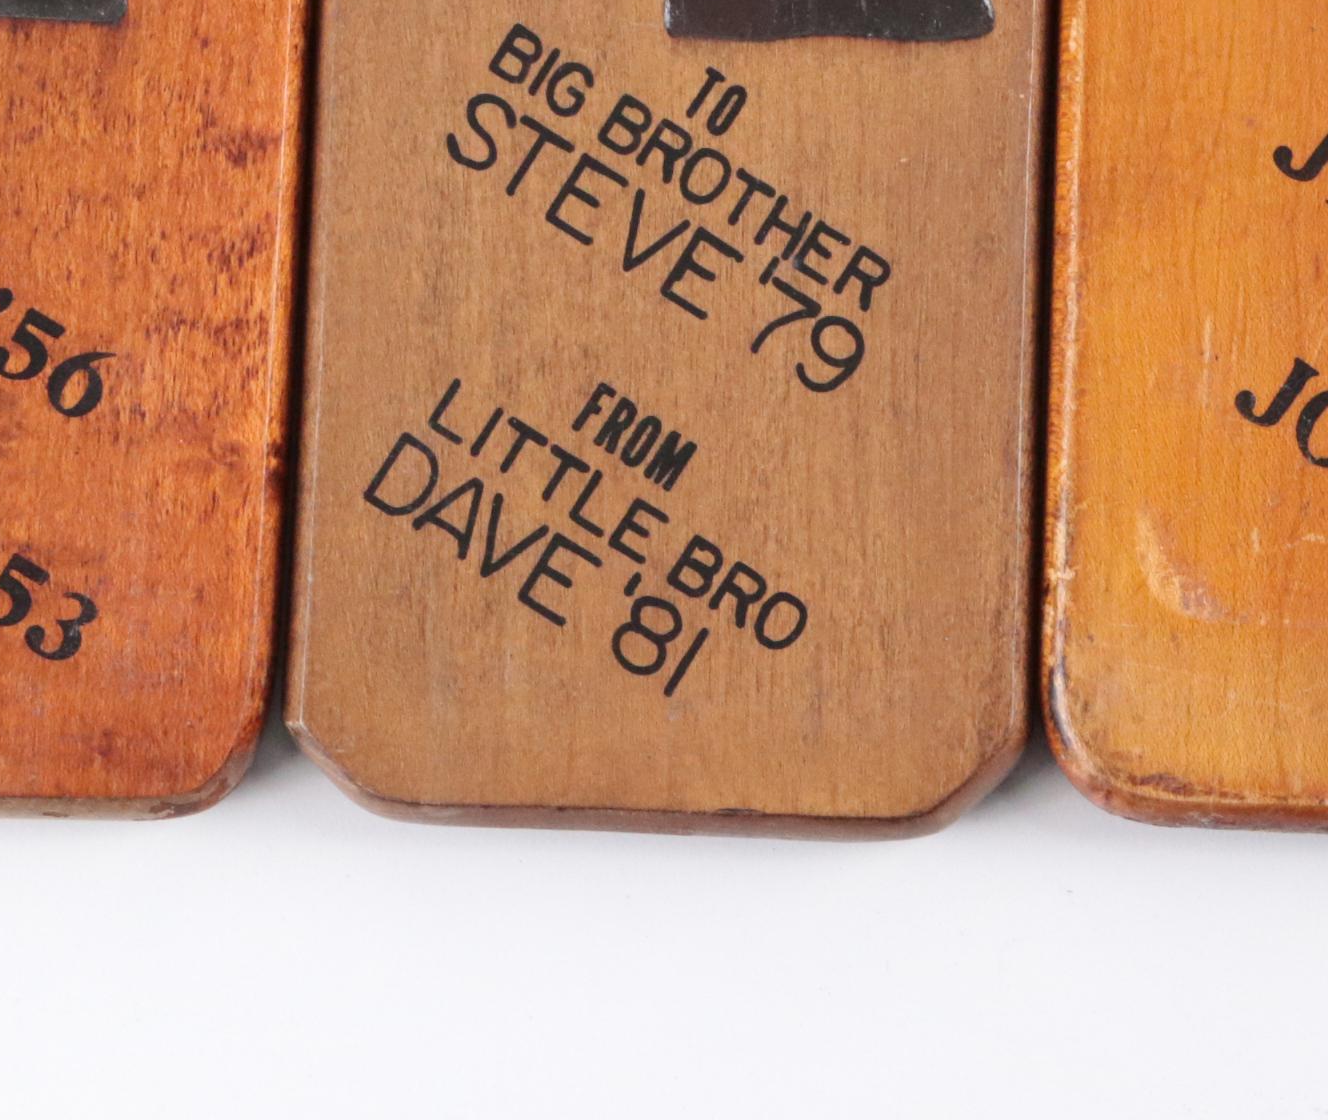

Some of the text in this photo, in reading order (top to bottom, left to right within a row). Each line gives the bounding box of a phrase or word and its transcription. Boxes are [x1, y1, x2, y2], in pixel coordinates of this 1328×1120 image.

[446, 94, 744, 319] STEVE
[489, 23, 890, 311] BIG BROTHER
[686, 67, 747, 136] TO
[364, 432, 602, 627] DAVE
[429, 379, 808, 650] LITTLE BRO
[571, 383, 697, 491] FROM
